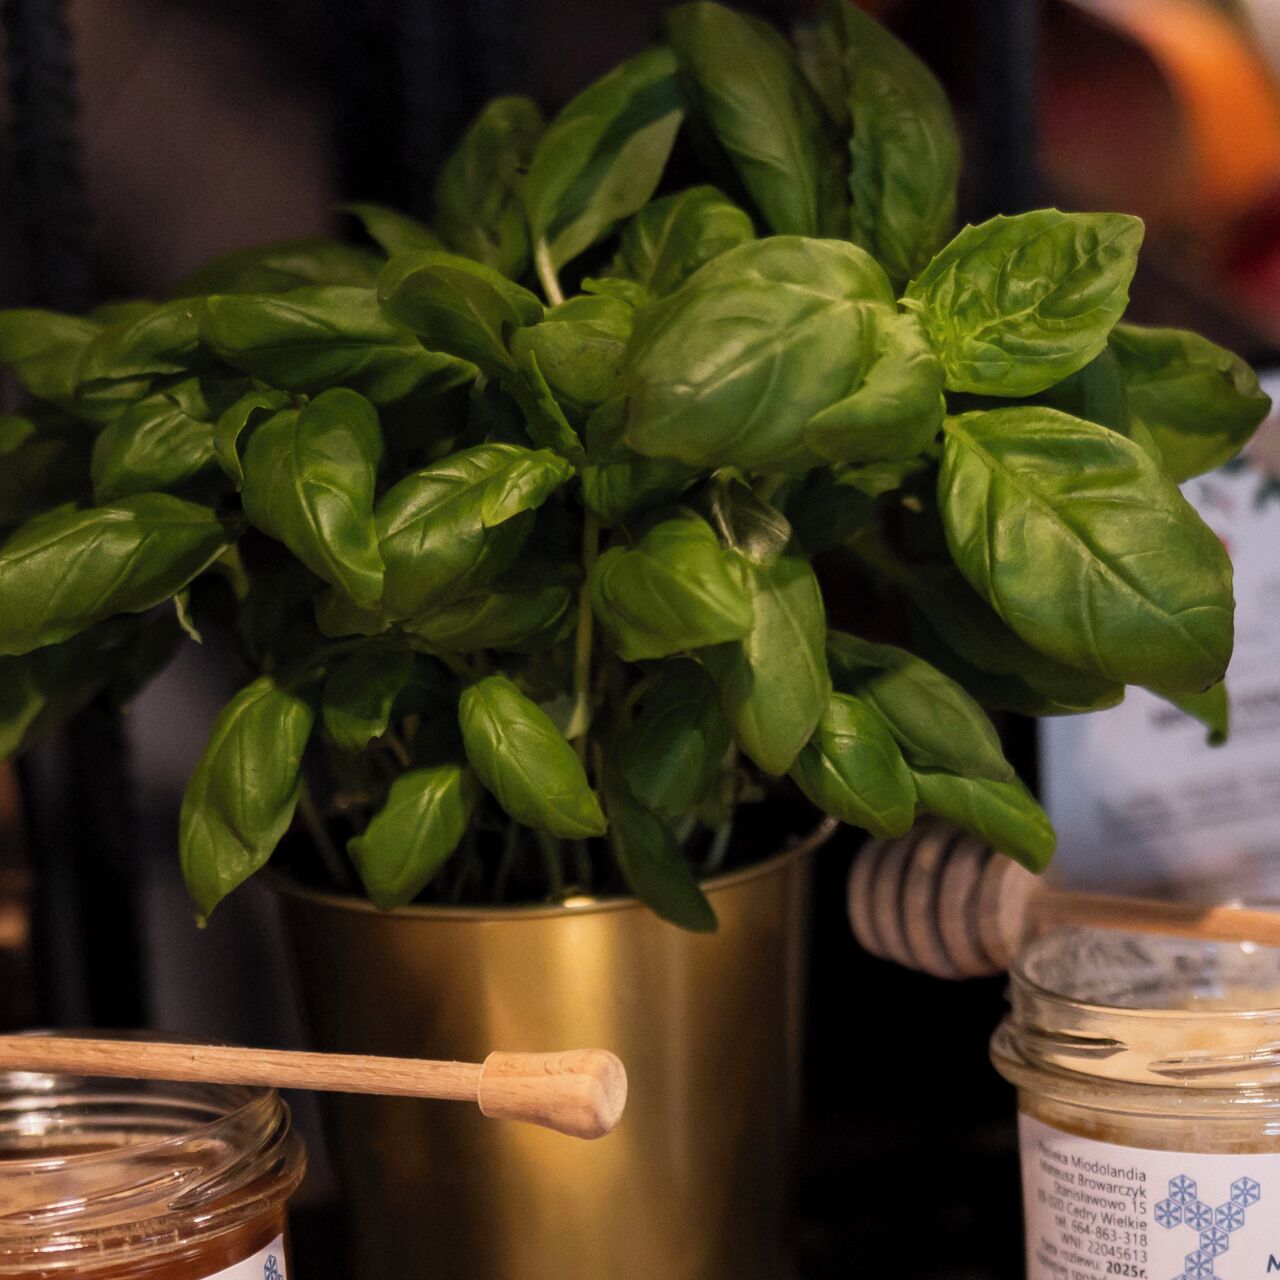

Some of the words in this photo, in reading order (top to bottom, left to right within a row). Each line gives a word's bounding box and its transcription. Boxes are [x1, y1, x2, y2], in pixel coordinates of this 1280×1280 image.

[1070, 1154, 1147, 1182] Miodolandia
[1078, 1173, 1147, 1201] Browarczyk
[1132, 1202, 1147, 1215] 15
[1100, 1211, 1148, 1231] Wielkie
[1088, 1239, 1148, 1264] 22045613
[1105, 1260, 1148, 1280] 2025r.
